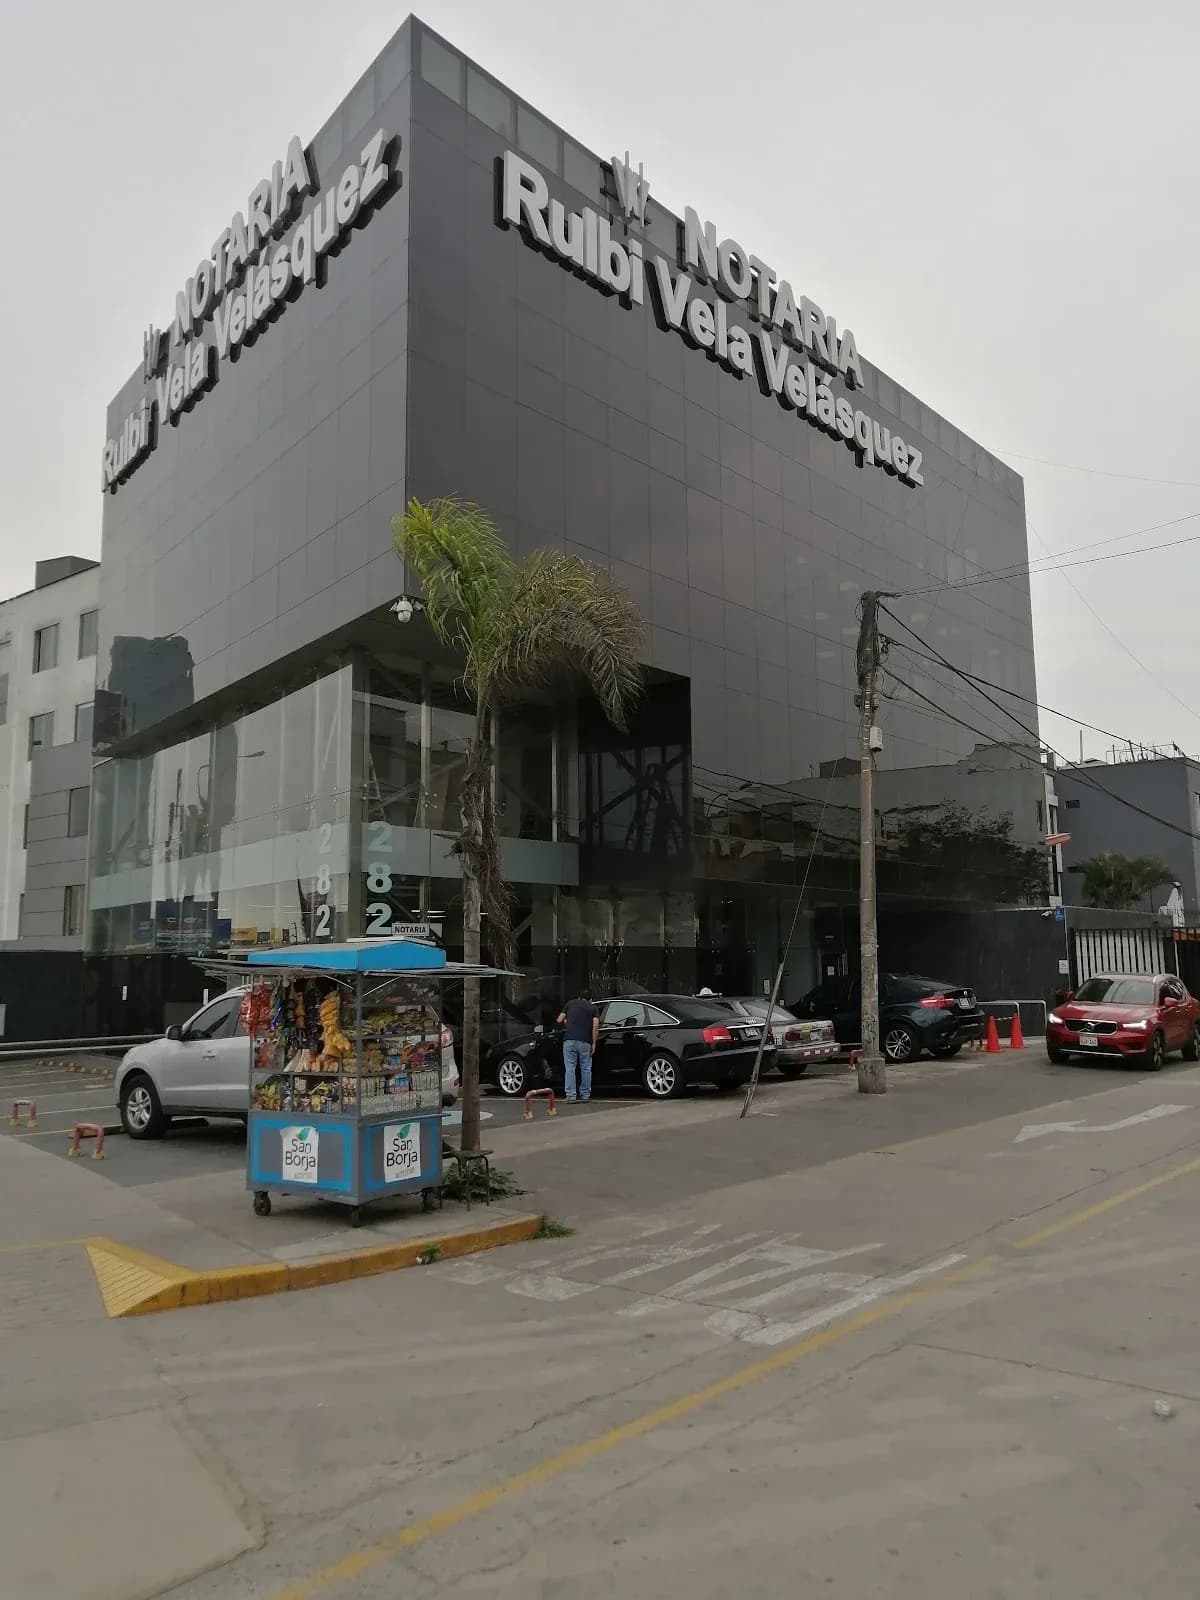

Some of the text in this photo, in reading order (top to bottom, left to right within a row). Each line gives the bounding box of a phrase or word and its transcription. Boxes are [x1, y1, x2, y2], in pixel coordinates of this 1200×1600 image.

[174, 135, 312, 346] NOTARIA
[102, 128, 388, 492] Rulbi Vela Velásquez
[503, 150, 642, 305] Rulbi
[654, 256, 752, 376] Vela
[759, 328, 923, 486] Velásquez
[685, 206, 863, 388] NOTARIA
[285, 1151, 316, 1171] Borja
[291, 1139, 311, 1152] San
[386, 1151, 418, 1168] Borja
[392, 1138, 412, 1151] San
